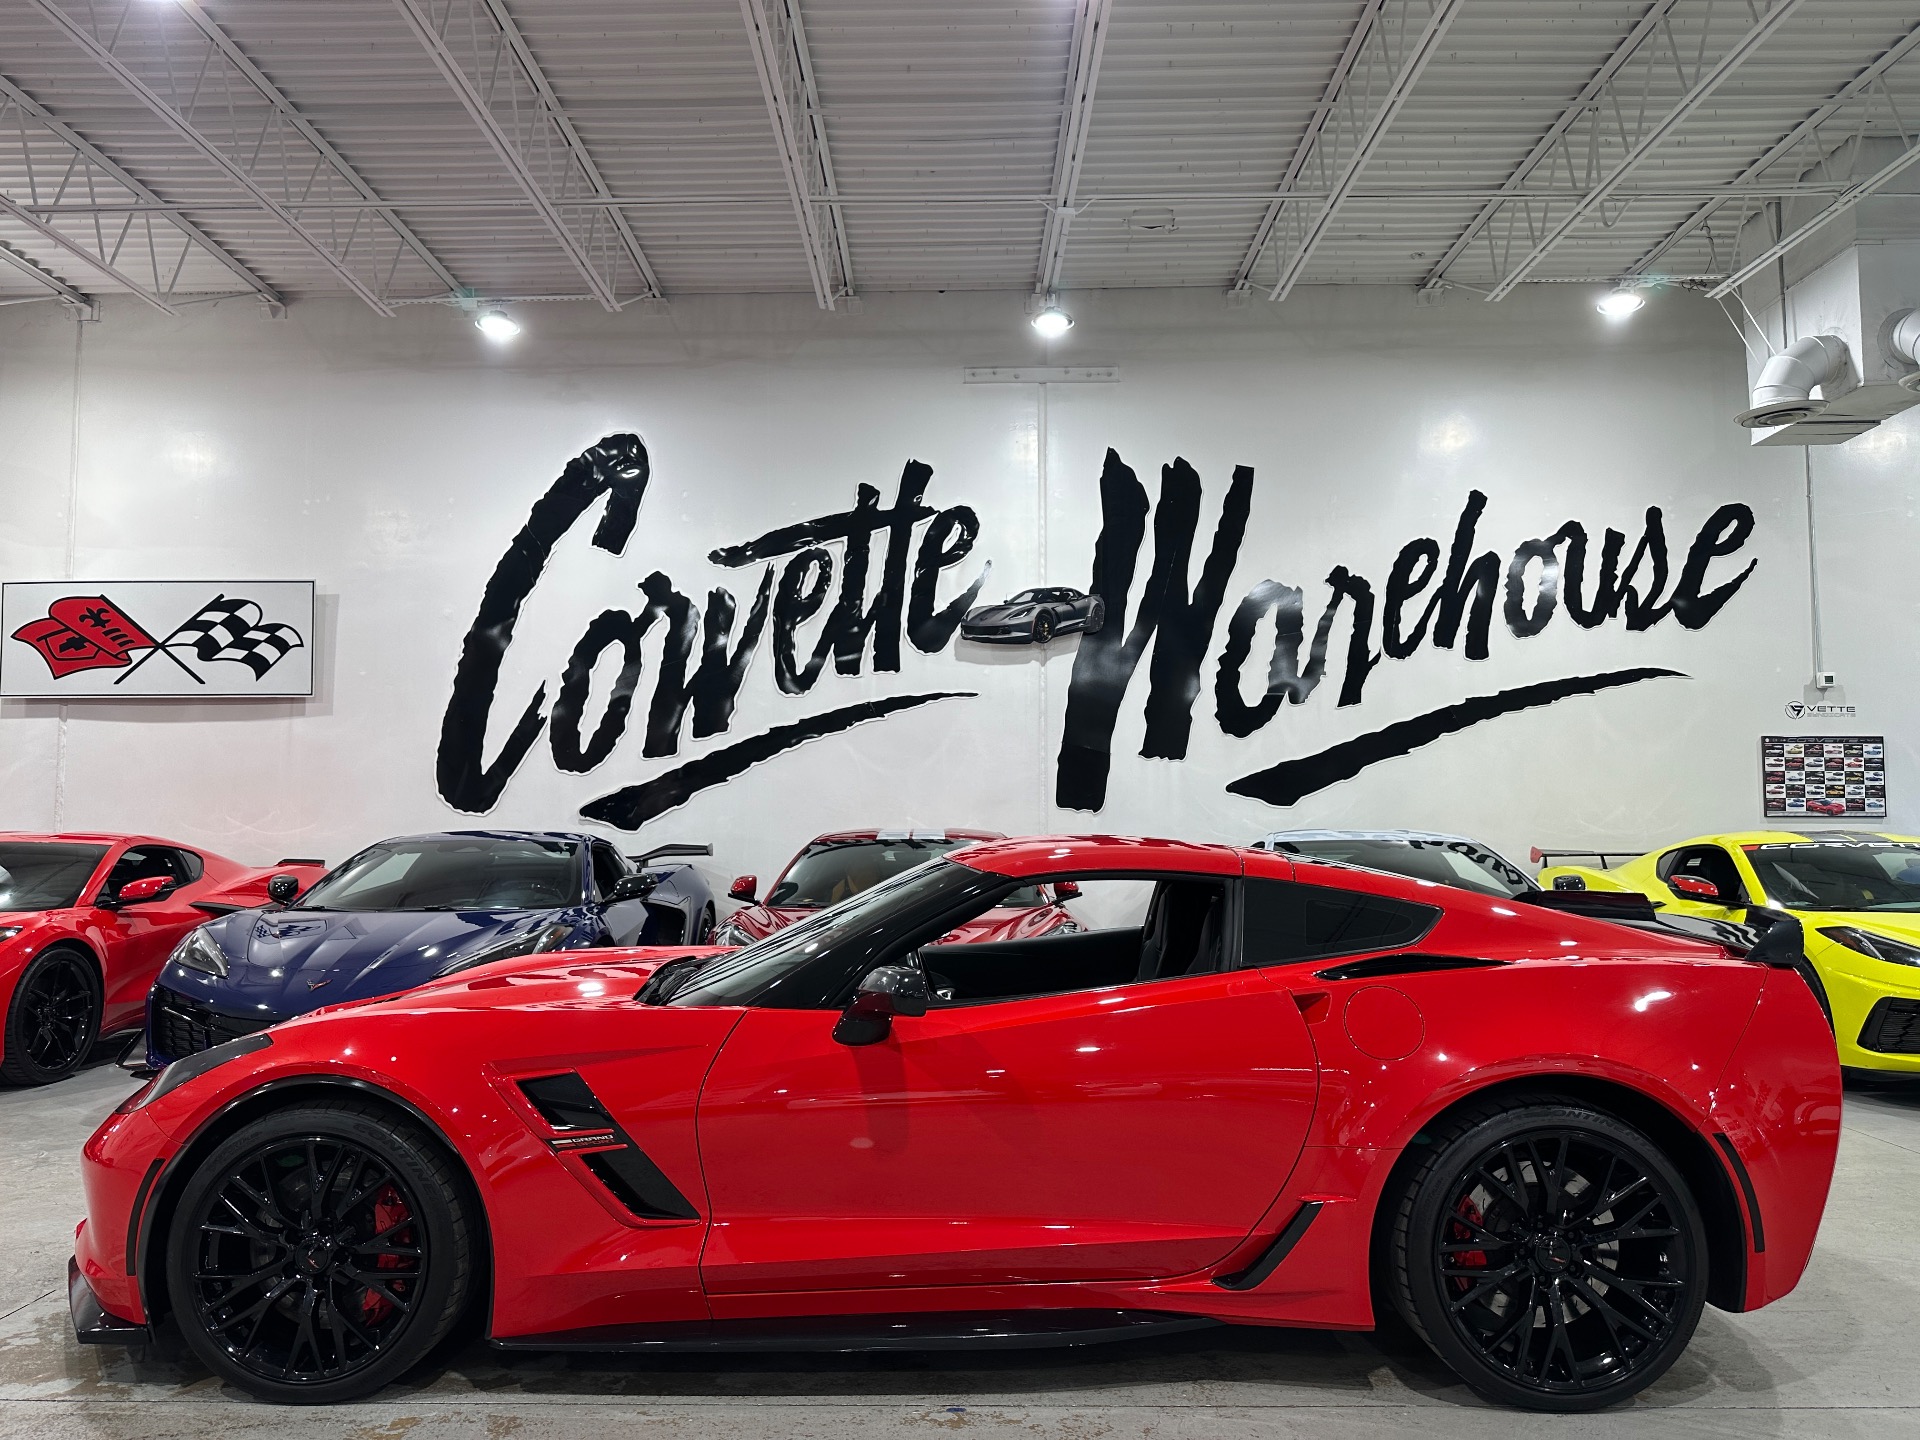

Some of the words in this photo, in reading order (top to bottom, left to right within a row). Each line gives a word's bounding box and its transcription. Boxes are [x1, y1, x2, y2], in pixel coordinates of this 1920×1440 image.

[436, 433, 992, 814] Corvette
[1055, 446, 1758, 811] Warehouse
[1806, 705, 1856, 713] VETTE
